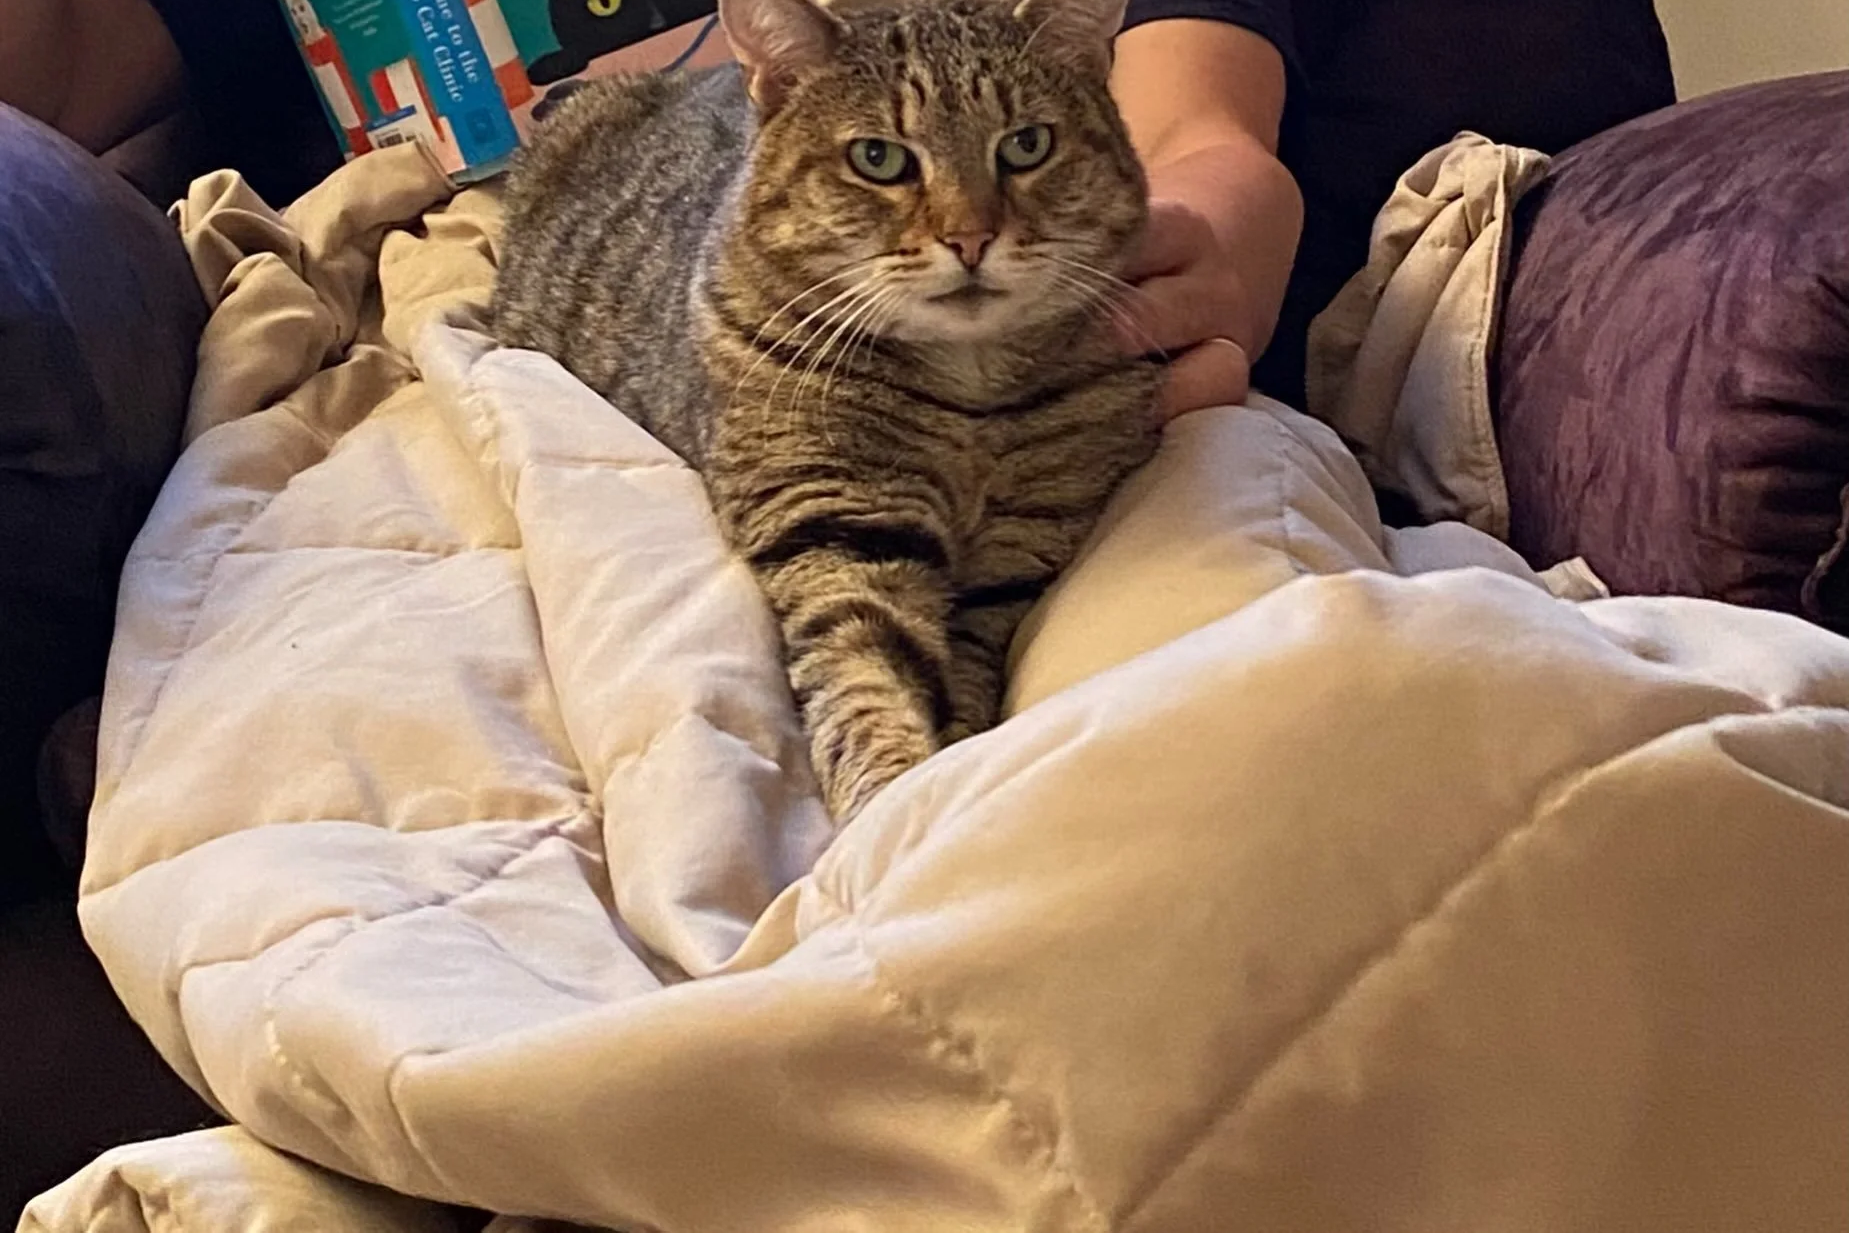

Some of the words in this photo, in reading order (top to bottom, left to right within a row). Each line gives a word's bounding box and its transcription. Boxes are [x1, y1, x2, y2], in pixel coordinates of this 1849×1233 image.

[416, 5, 440, 44] Cat
[433, 45, 465, 104] Clinic
[447, 24, 464, 47] to
[458, 50, 480, 84] the
